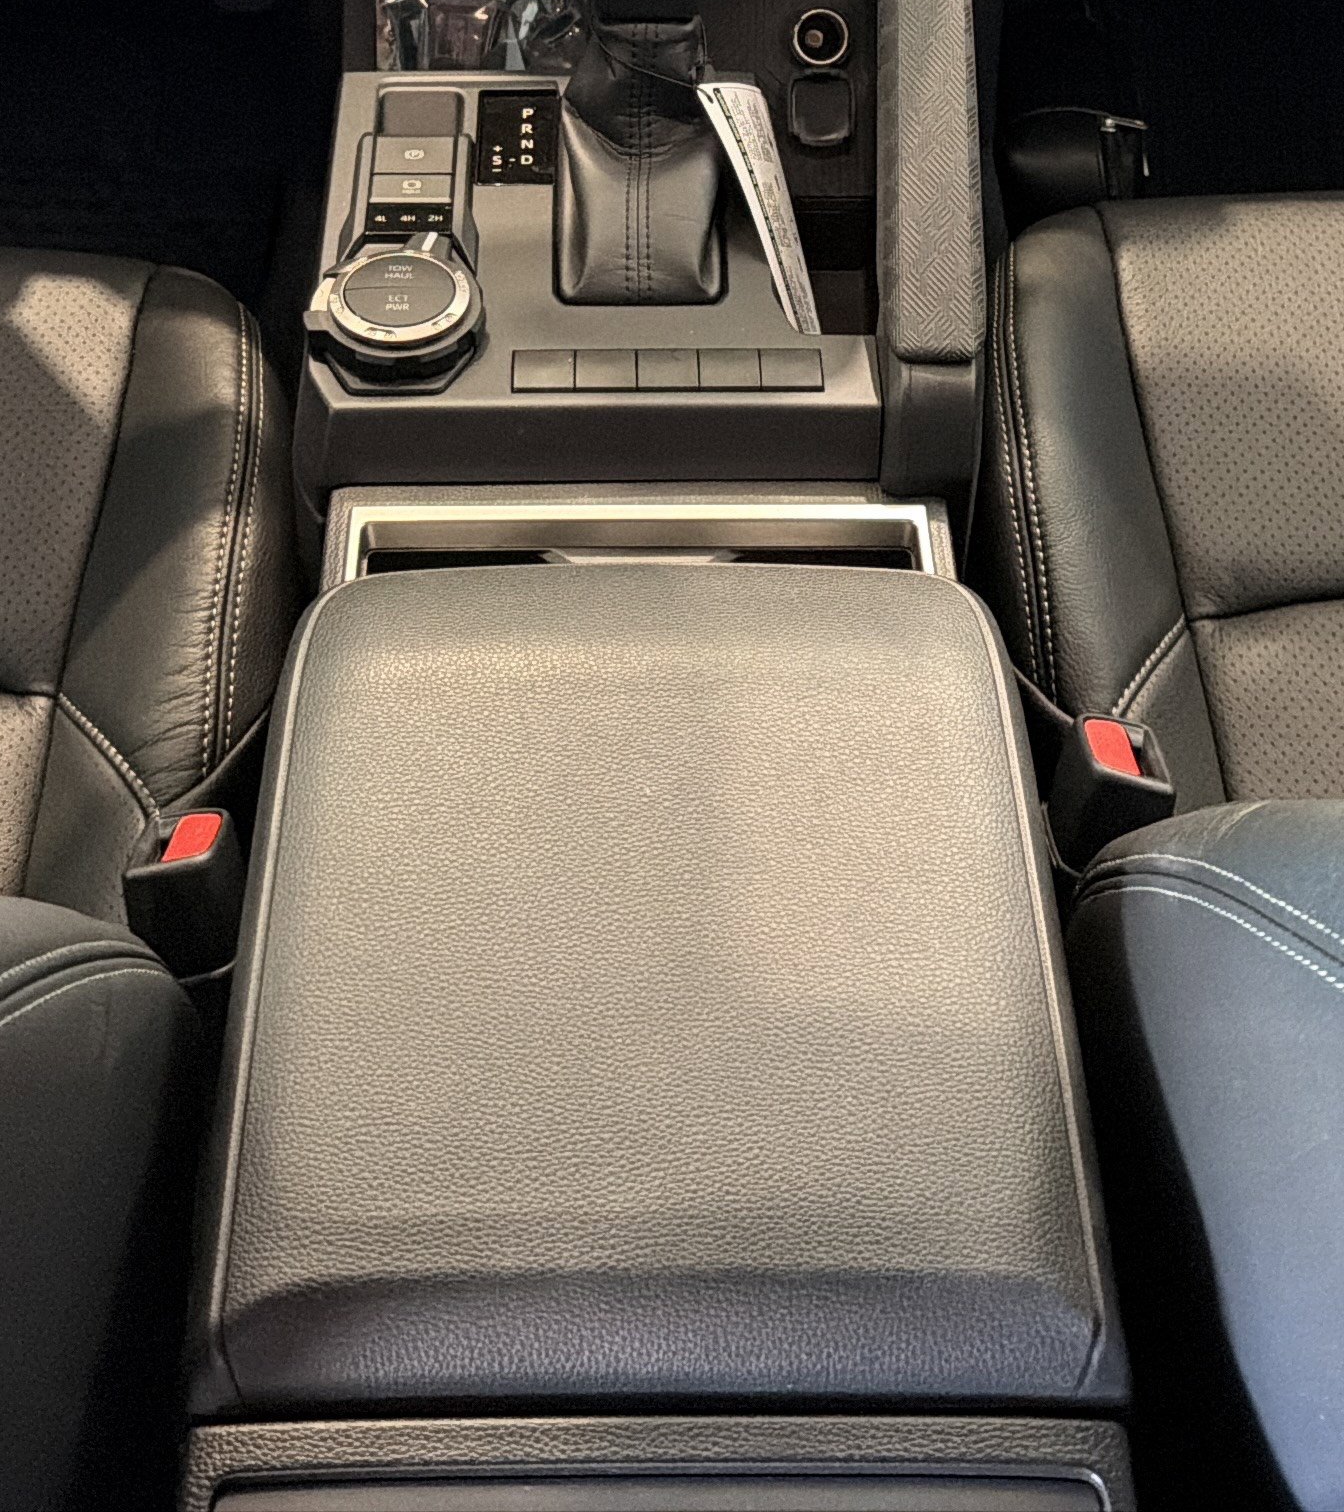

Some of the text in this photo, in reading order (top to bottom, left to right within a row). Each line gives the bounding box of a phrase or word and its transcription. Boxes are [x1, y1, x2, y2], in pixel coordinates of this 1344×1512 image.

[522, 108, 534, 119] P
[521, 123, 533, 134] R
[521, 139, 534, 149] N
[520, 154, 533, 165] D
[400, 214, 416, 222] 4H
[427, 214, 443, 222] 2H
[388, 294, 409, 302] ECT
[385, 303, 410, 311] PWR
